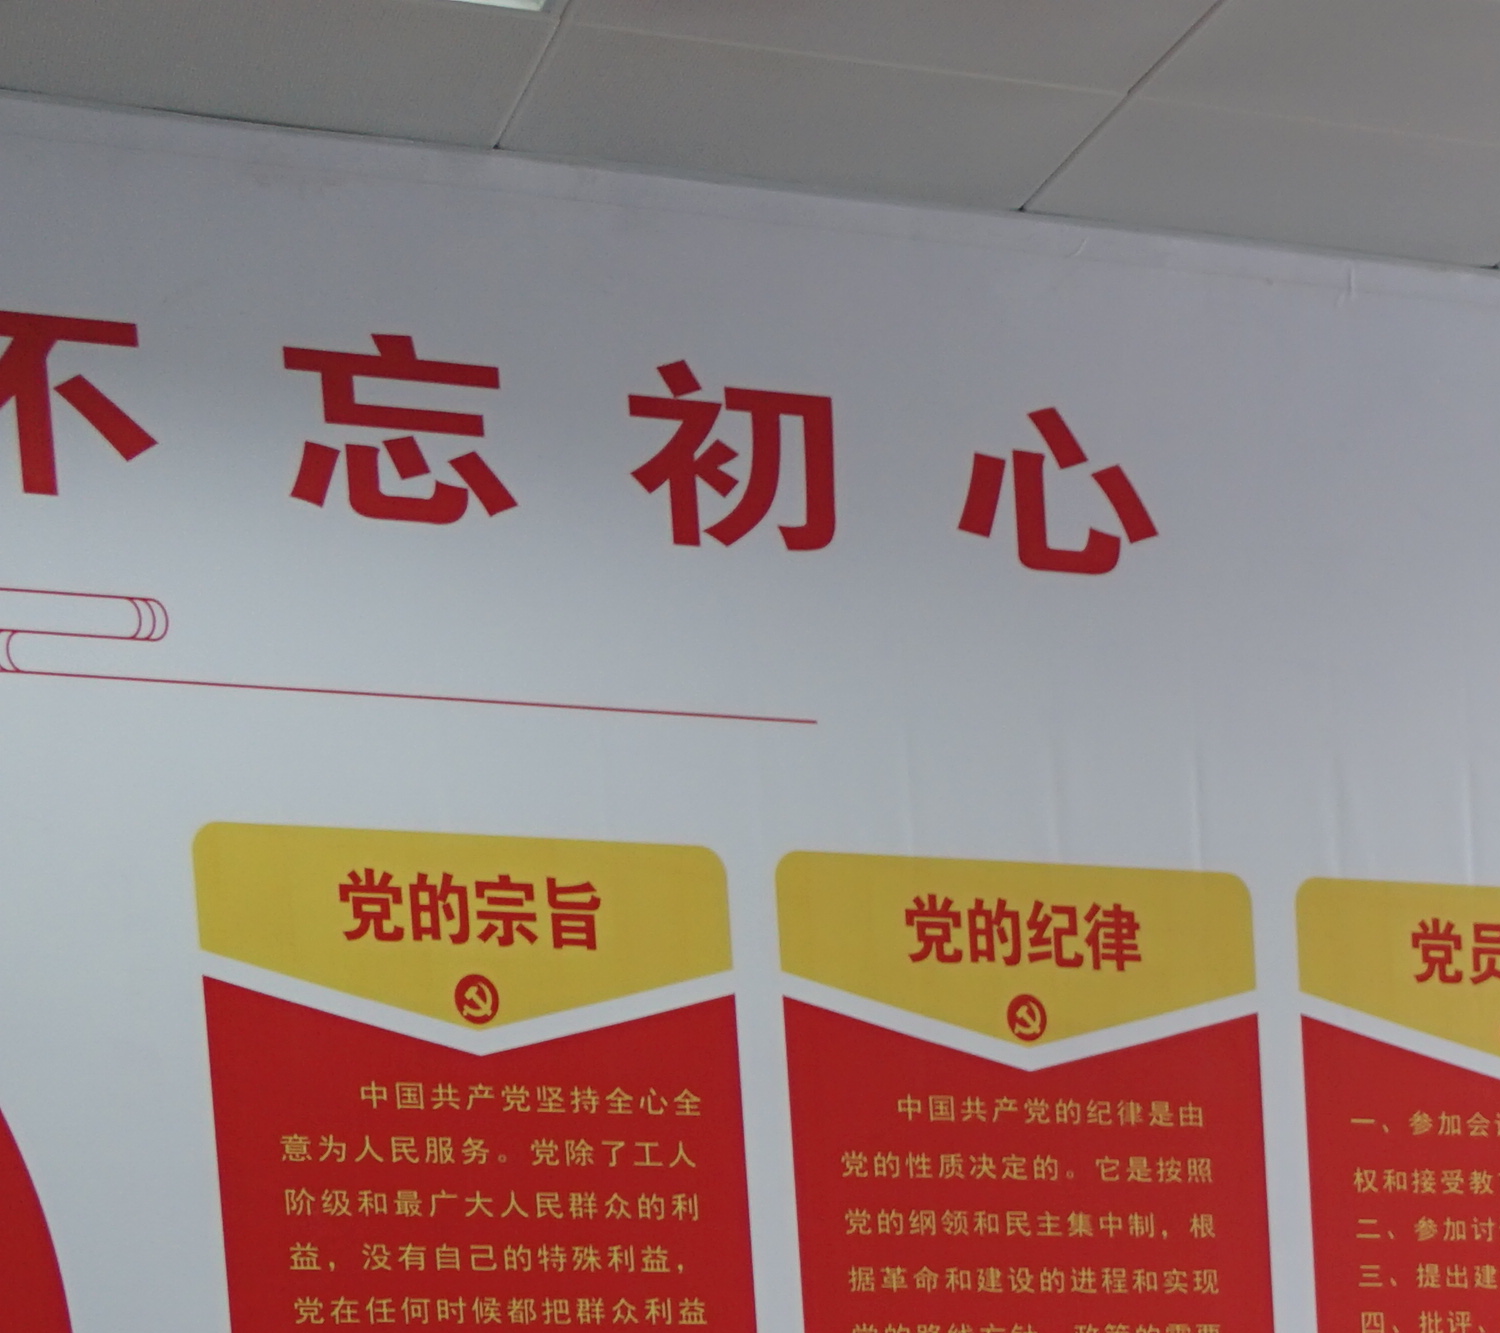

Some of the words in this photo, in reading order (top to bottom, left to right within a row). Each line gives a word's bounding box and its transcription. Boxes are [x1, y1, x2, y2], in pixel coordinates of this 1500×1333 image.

[0, 312, 1157, 576] 不忘初心
[340, 869, 602, 951] 党的宗旨
[906, 895, 1142, 972] 党的纪律
[361, 1083, 701, 1116] 中国共产党坚持全心全
[282, 1135, 696, 1168] 意为人民服务。党除了工人
[285, 1190, 699, 1221] 阶级和最广大人民群众的利
[290, 1245, 687, 1273] 益，没有自己的特殊利益，
[295, 1299, 708, 1325] 党在任何时候都把群众利益
